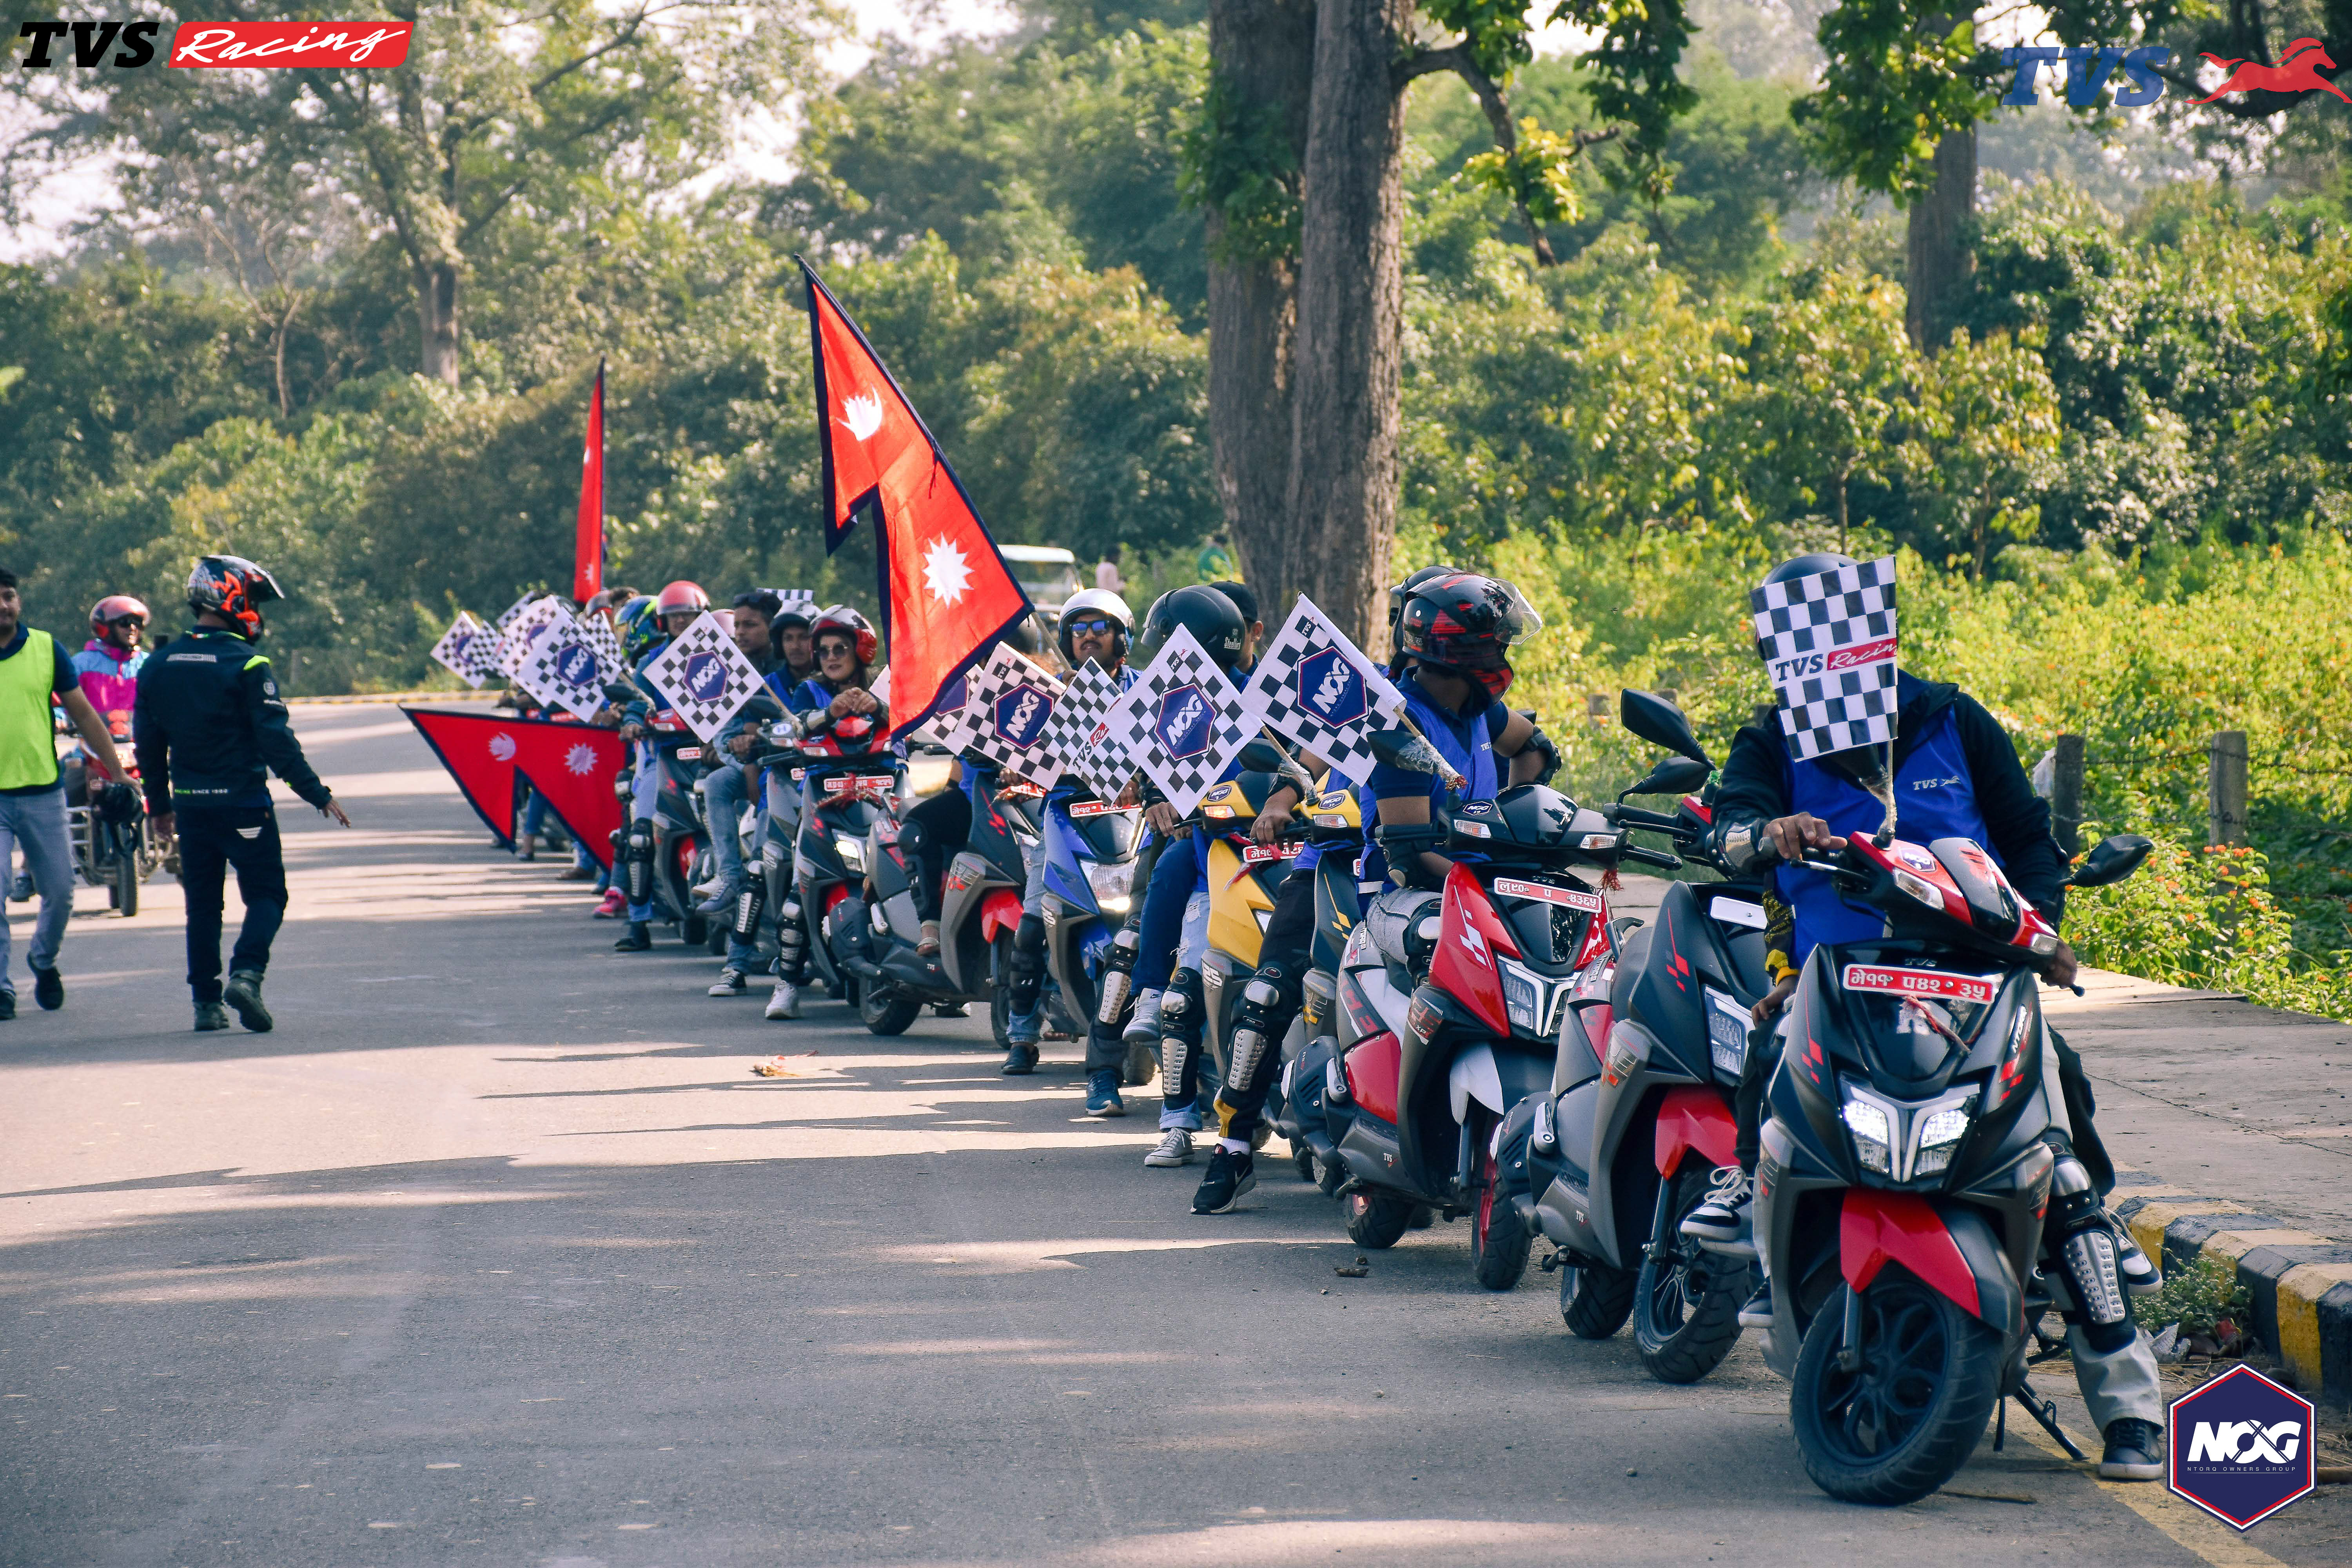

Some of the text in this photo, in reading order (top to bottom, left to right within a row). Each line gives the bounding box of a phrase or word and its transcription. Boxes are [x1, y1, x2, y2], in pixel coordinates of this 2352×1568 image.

[1301, 622, 1312, 635] TVS
[691, 657, 721, 693] NOG
[1775, 653, 1824, 682] TVS
[1312, 657, 1350, 714] NOG
[1005, 690, 1040, 740] NOG
[1166, 693, 1203, 746] NOG
[1073, 740, 1093, 771] TVS
[1480, 742, 1492, 751] TVS
[1913, 778, 1938, 791] TVS
[1416, 1025, 1427, 1034] XP
[1383, 1152, 1392, 1163] TVS
[1576, 1210, 1584, 1223] TVS
